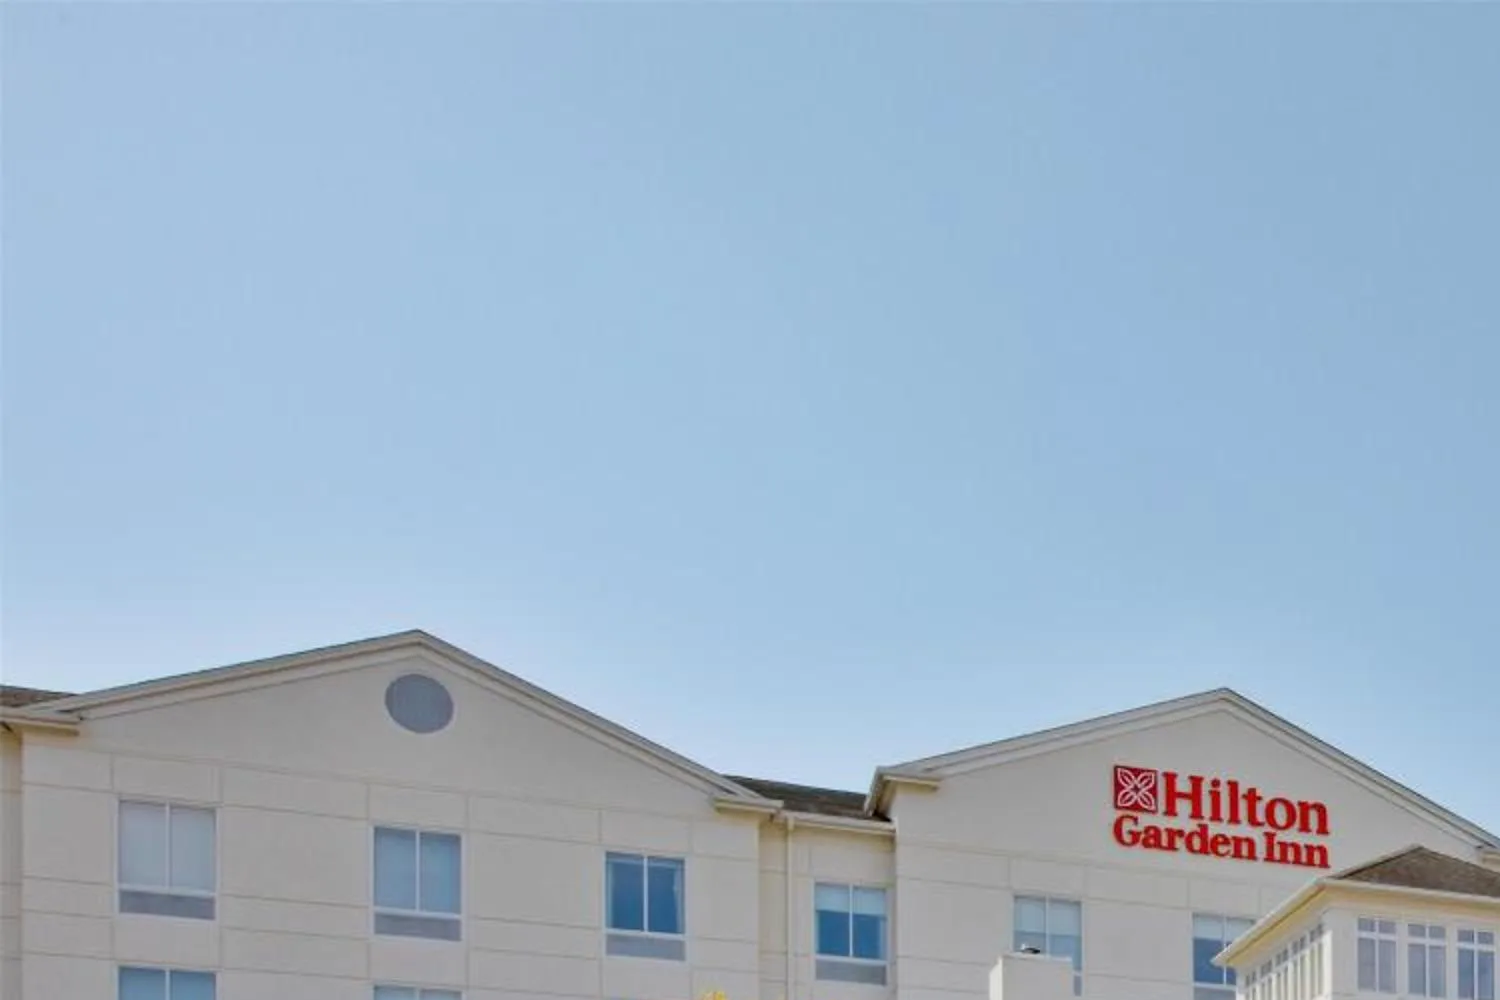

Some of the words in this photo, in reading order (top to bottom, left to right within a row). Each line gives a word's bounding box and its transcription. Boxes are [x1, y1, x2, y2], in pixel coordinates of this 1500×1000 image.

[1162, 771, 1329, 835] Hilton
[1113, 814, 1257, 861] Garden
[1263, 831, 1330, 868] Inn
